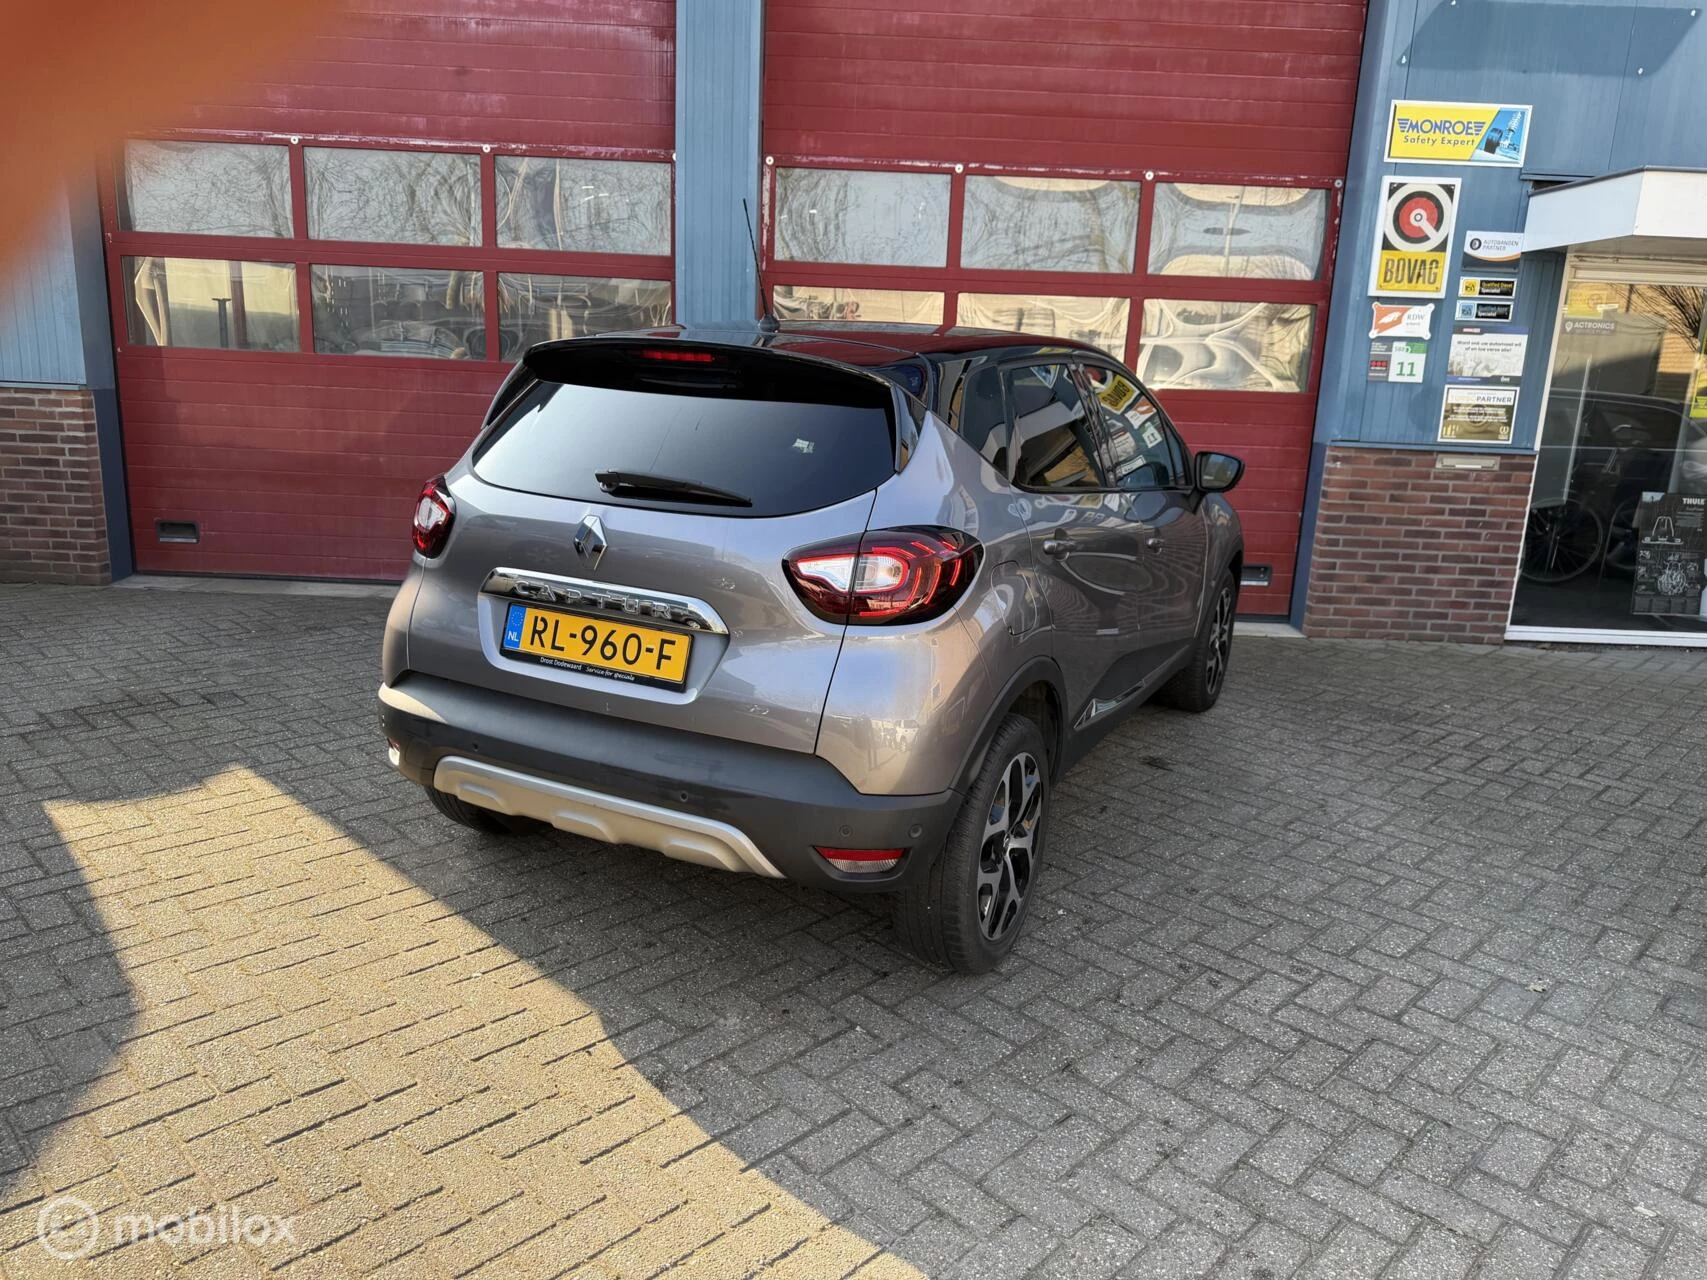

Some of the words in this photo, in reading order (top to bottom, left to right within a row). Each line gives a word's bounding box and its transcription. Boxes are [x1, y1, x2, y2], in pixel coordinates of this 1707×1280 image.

[1406, 118, 1474, 136] MONROE
[1403, 134, 1438, 146] Safety
[1440, 136, 1475, 148] Expert
[1383, 257, 1440, 285] BOVAG
[1573, 321, 1615, 330] ACTRONICS
[1396, 361, 1417, 377] 11
[1477, 395, 1512, 403] PARTNER
[1682, 497, 1705, 505] THULE
[514, 580, 673, 620] CAPTUR
[507, 630, 520, 642] NL
[529, 615, 677, 671] RL-960-F
[540, 656, 553, 665] Drost
[553, 659, 582, 671] Dodewaard
[585, 666, 605, 675] Service
